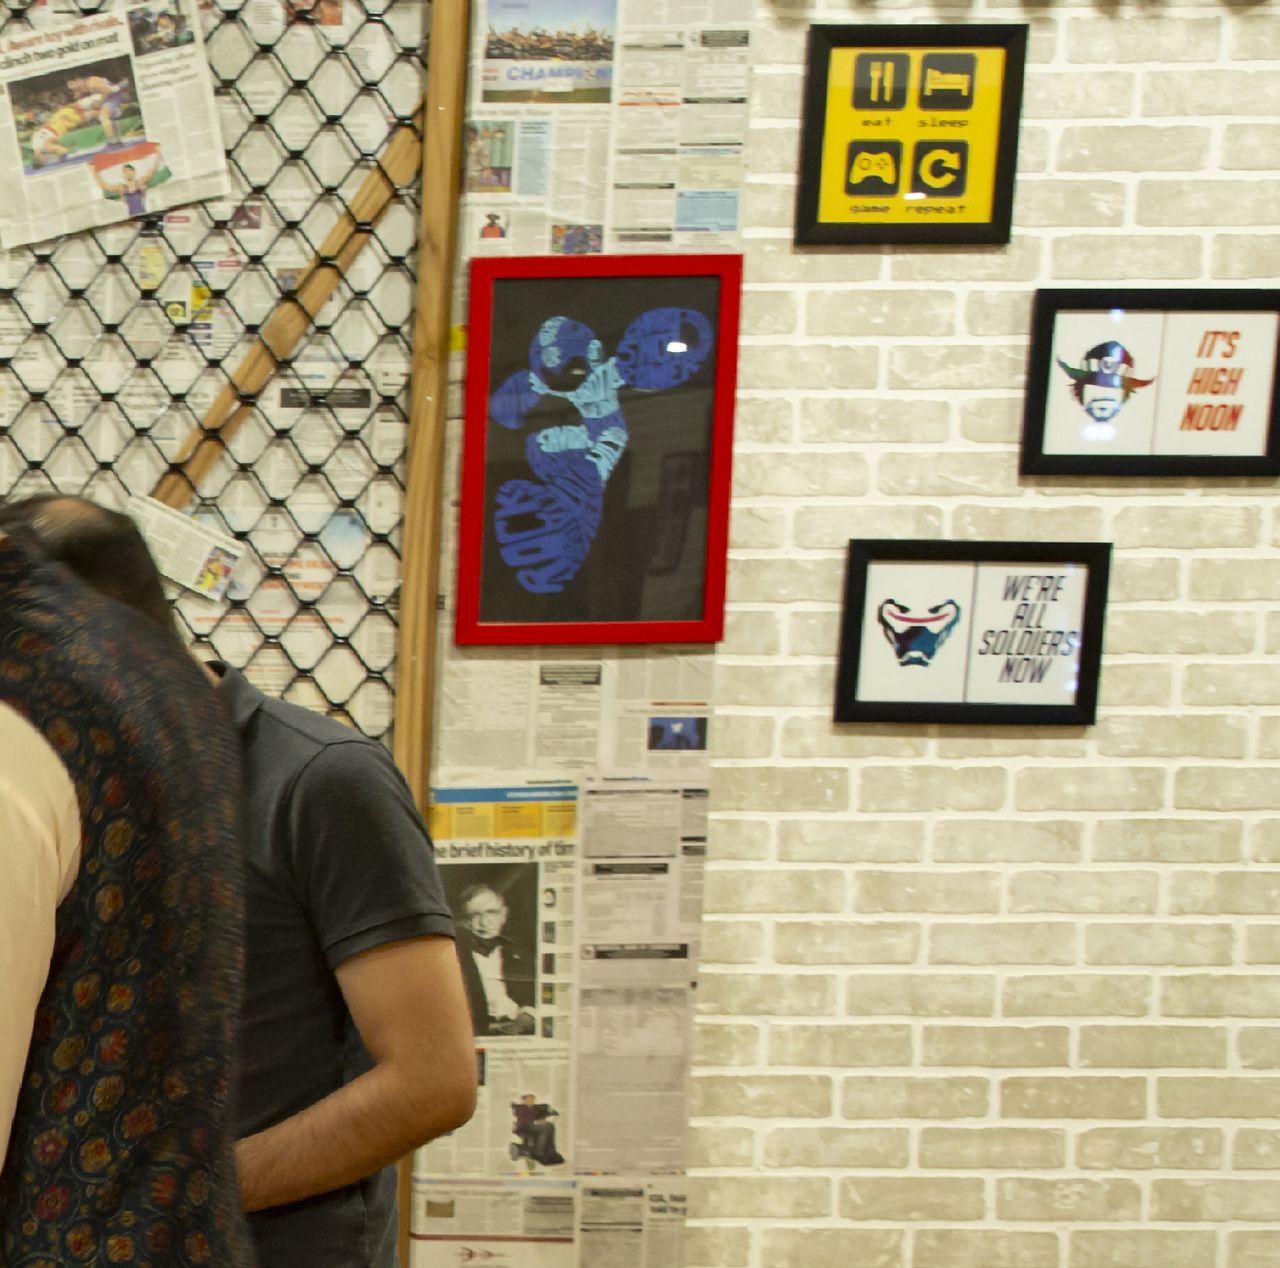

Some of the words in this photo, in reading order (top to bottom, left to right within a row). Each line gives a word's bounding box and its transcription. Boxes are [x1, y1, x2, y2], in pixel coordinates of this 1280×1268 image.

[861, 117, 891, 127] eat
[917, 117, 968, 128] sleep
[849, 204, 890, 215] game
[905, 204, 967, 215] repeat
[1197, 331, 1240, 359] IT'S
[1187, 367, 1244, 395] HIGH
[1179, 404, 1244, 431] NOON
[1002, 575, 1065, 602] WE'RE
[1011, 603, 1043, 629] ALL
[978, 630, 1077, 657] SOLDIERS
[998, 658, 1052, 684] NOW
[450, 843, 483, 857] brief
[485, 842, 534, 859] history
[539, 841, 552, 856] of
